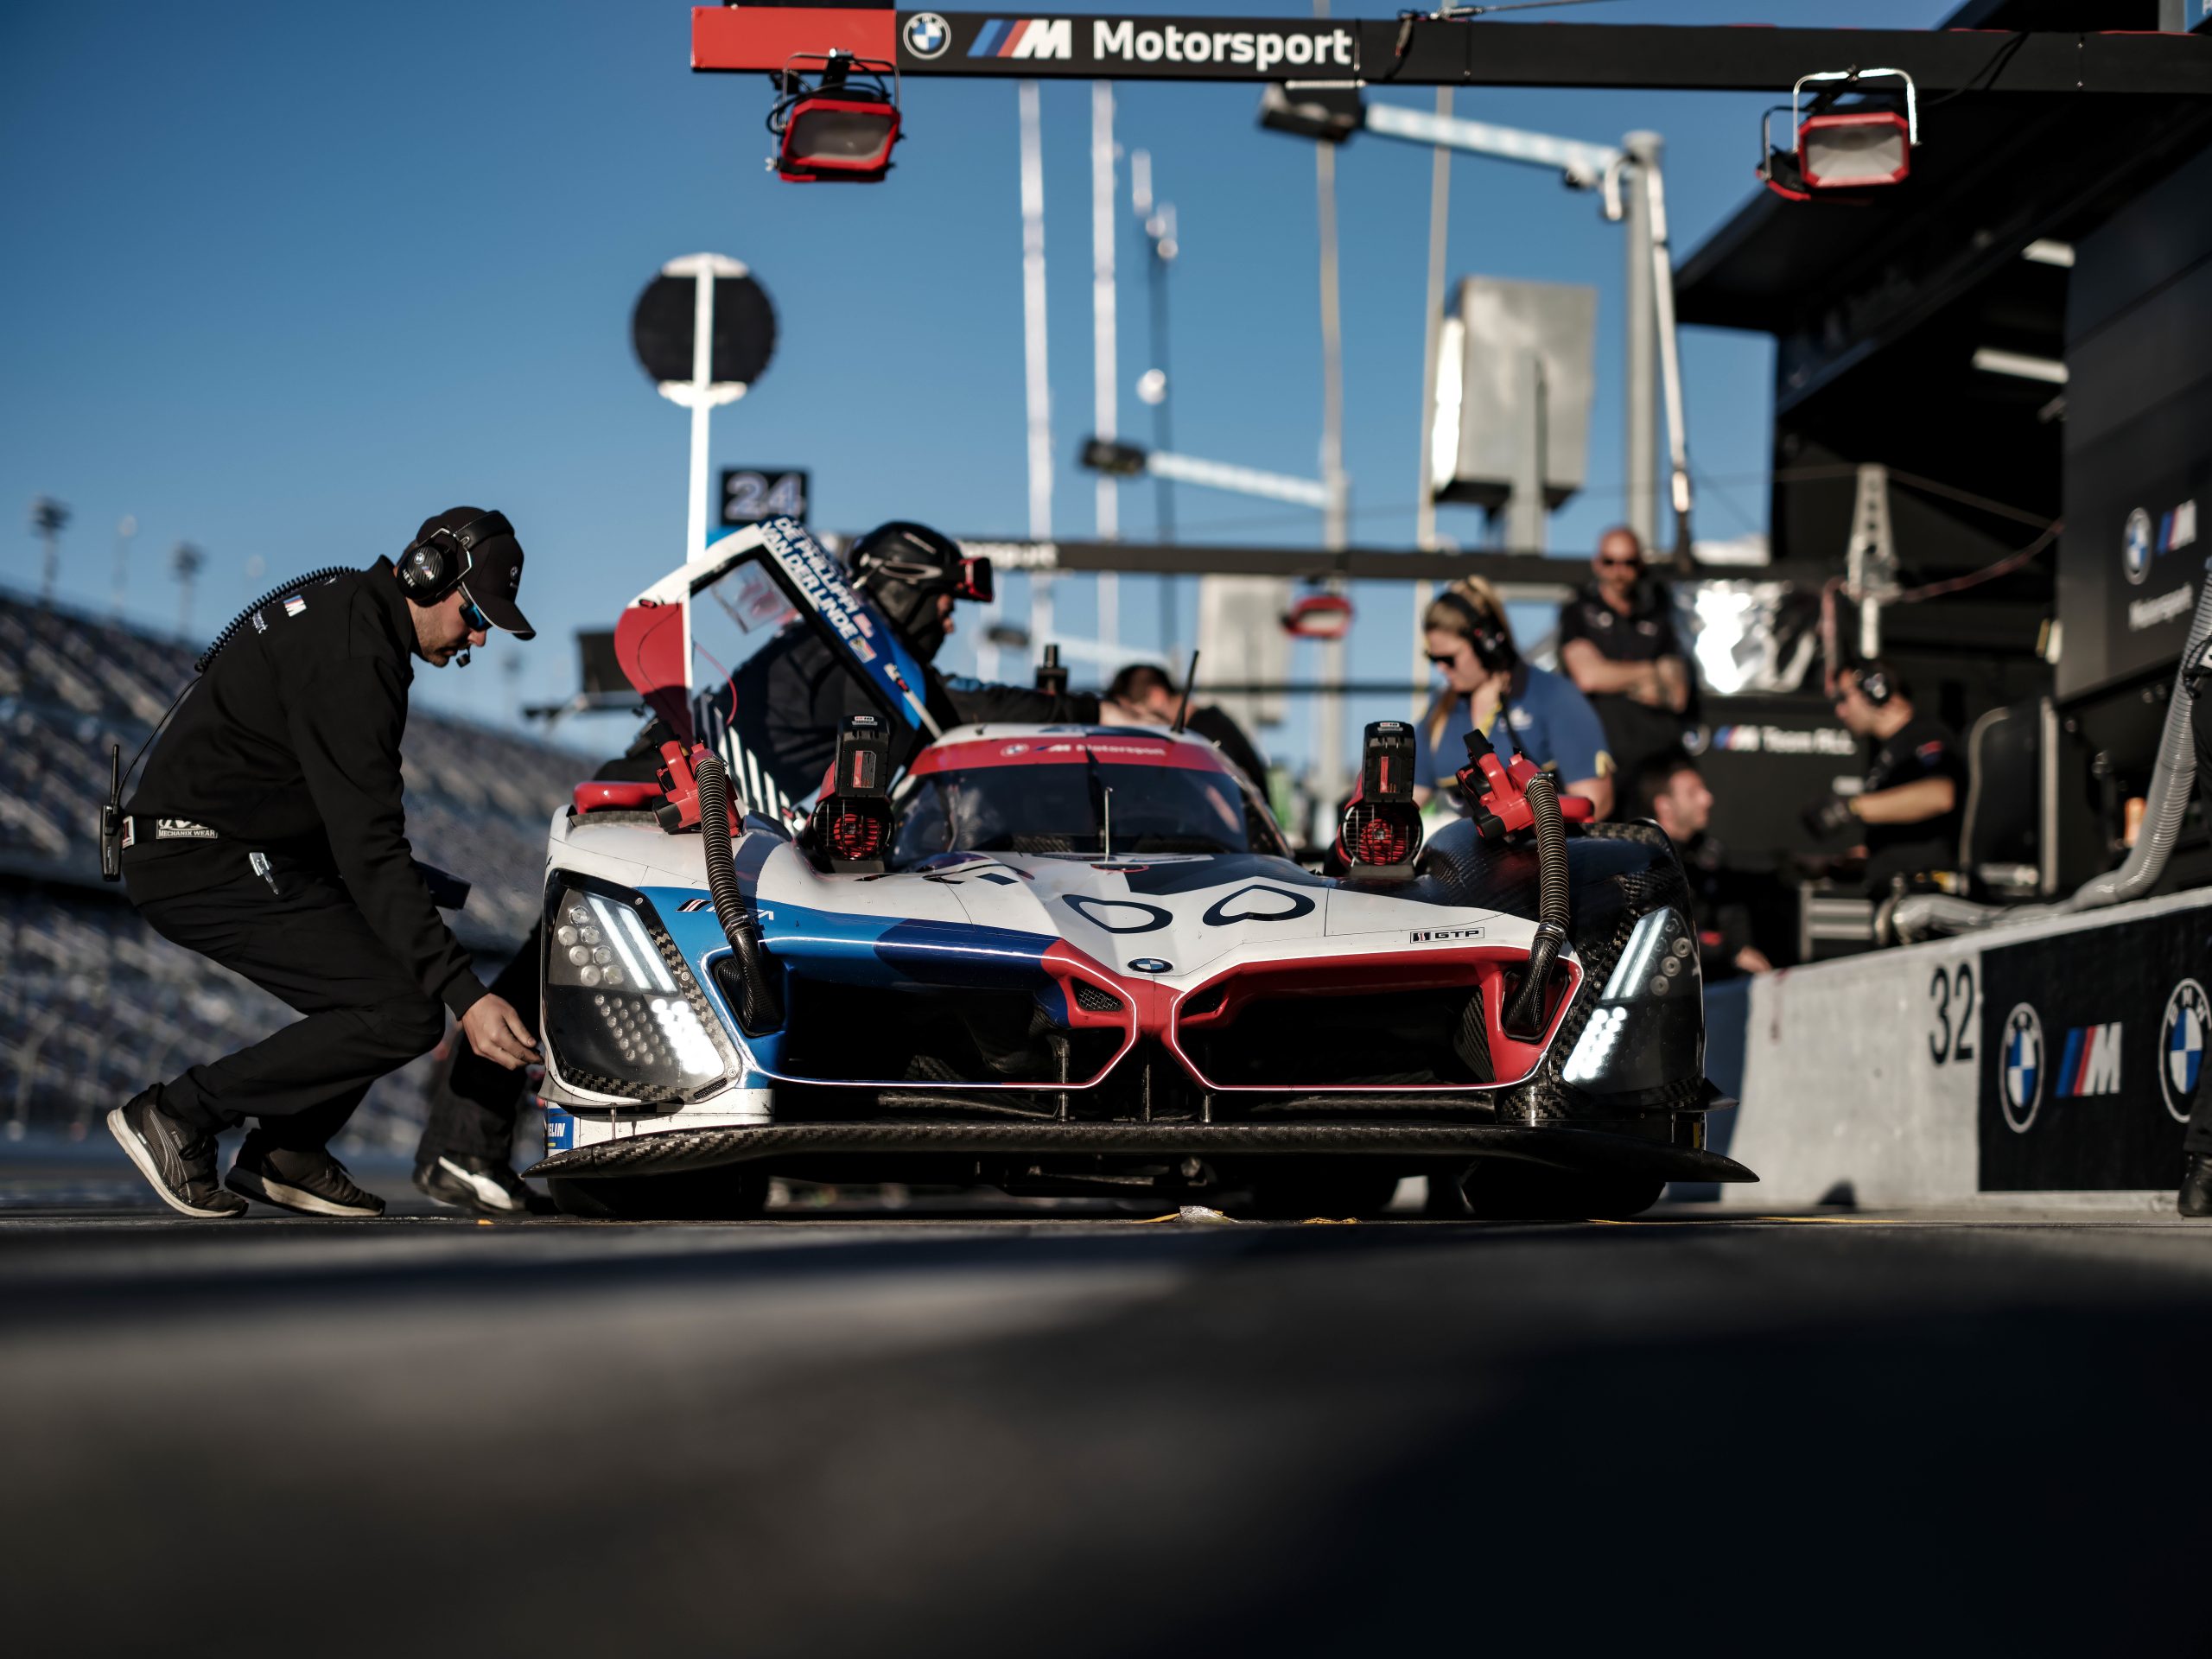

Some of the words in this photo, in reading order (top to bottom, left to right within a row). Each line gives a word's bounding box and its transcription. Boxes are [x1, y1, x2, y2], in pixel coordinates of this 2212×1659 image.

[1093, 20, 1353, 72] Motorsport
[725, 472, 804, 521] 24
[760, 521, 793, 555] VAN
[785, 553, 821, 591] DER
[813, 588, 860, 640] LINDE
[774, 517, 802, 543] DE
[794, 537, 859, 613] PHILLIPPI
[194, 829, 215, 837] WEAR
[1435, 930, 1479, 938] GTP
[1929, 960, 1974, 1065] 32
